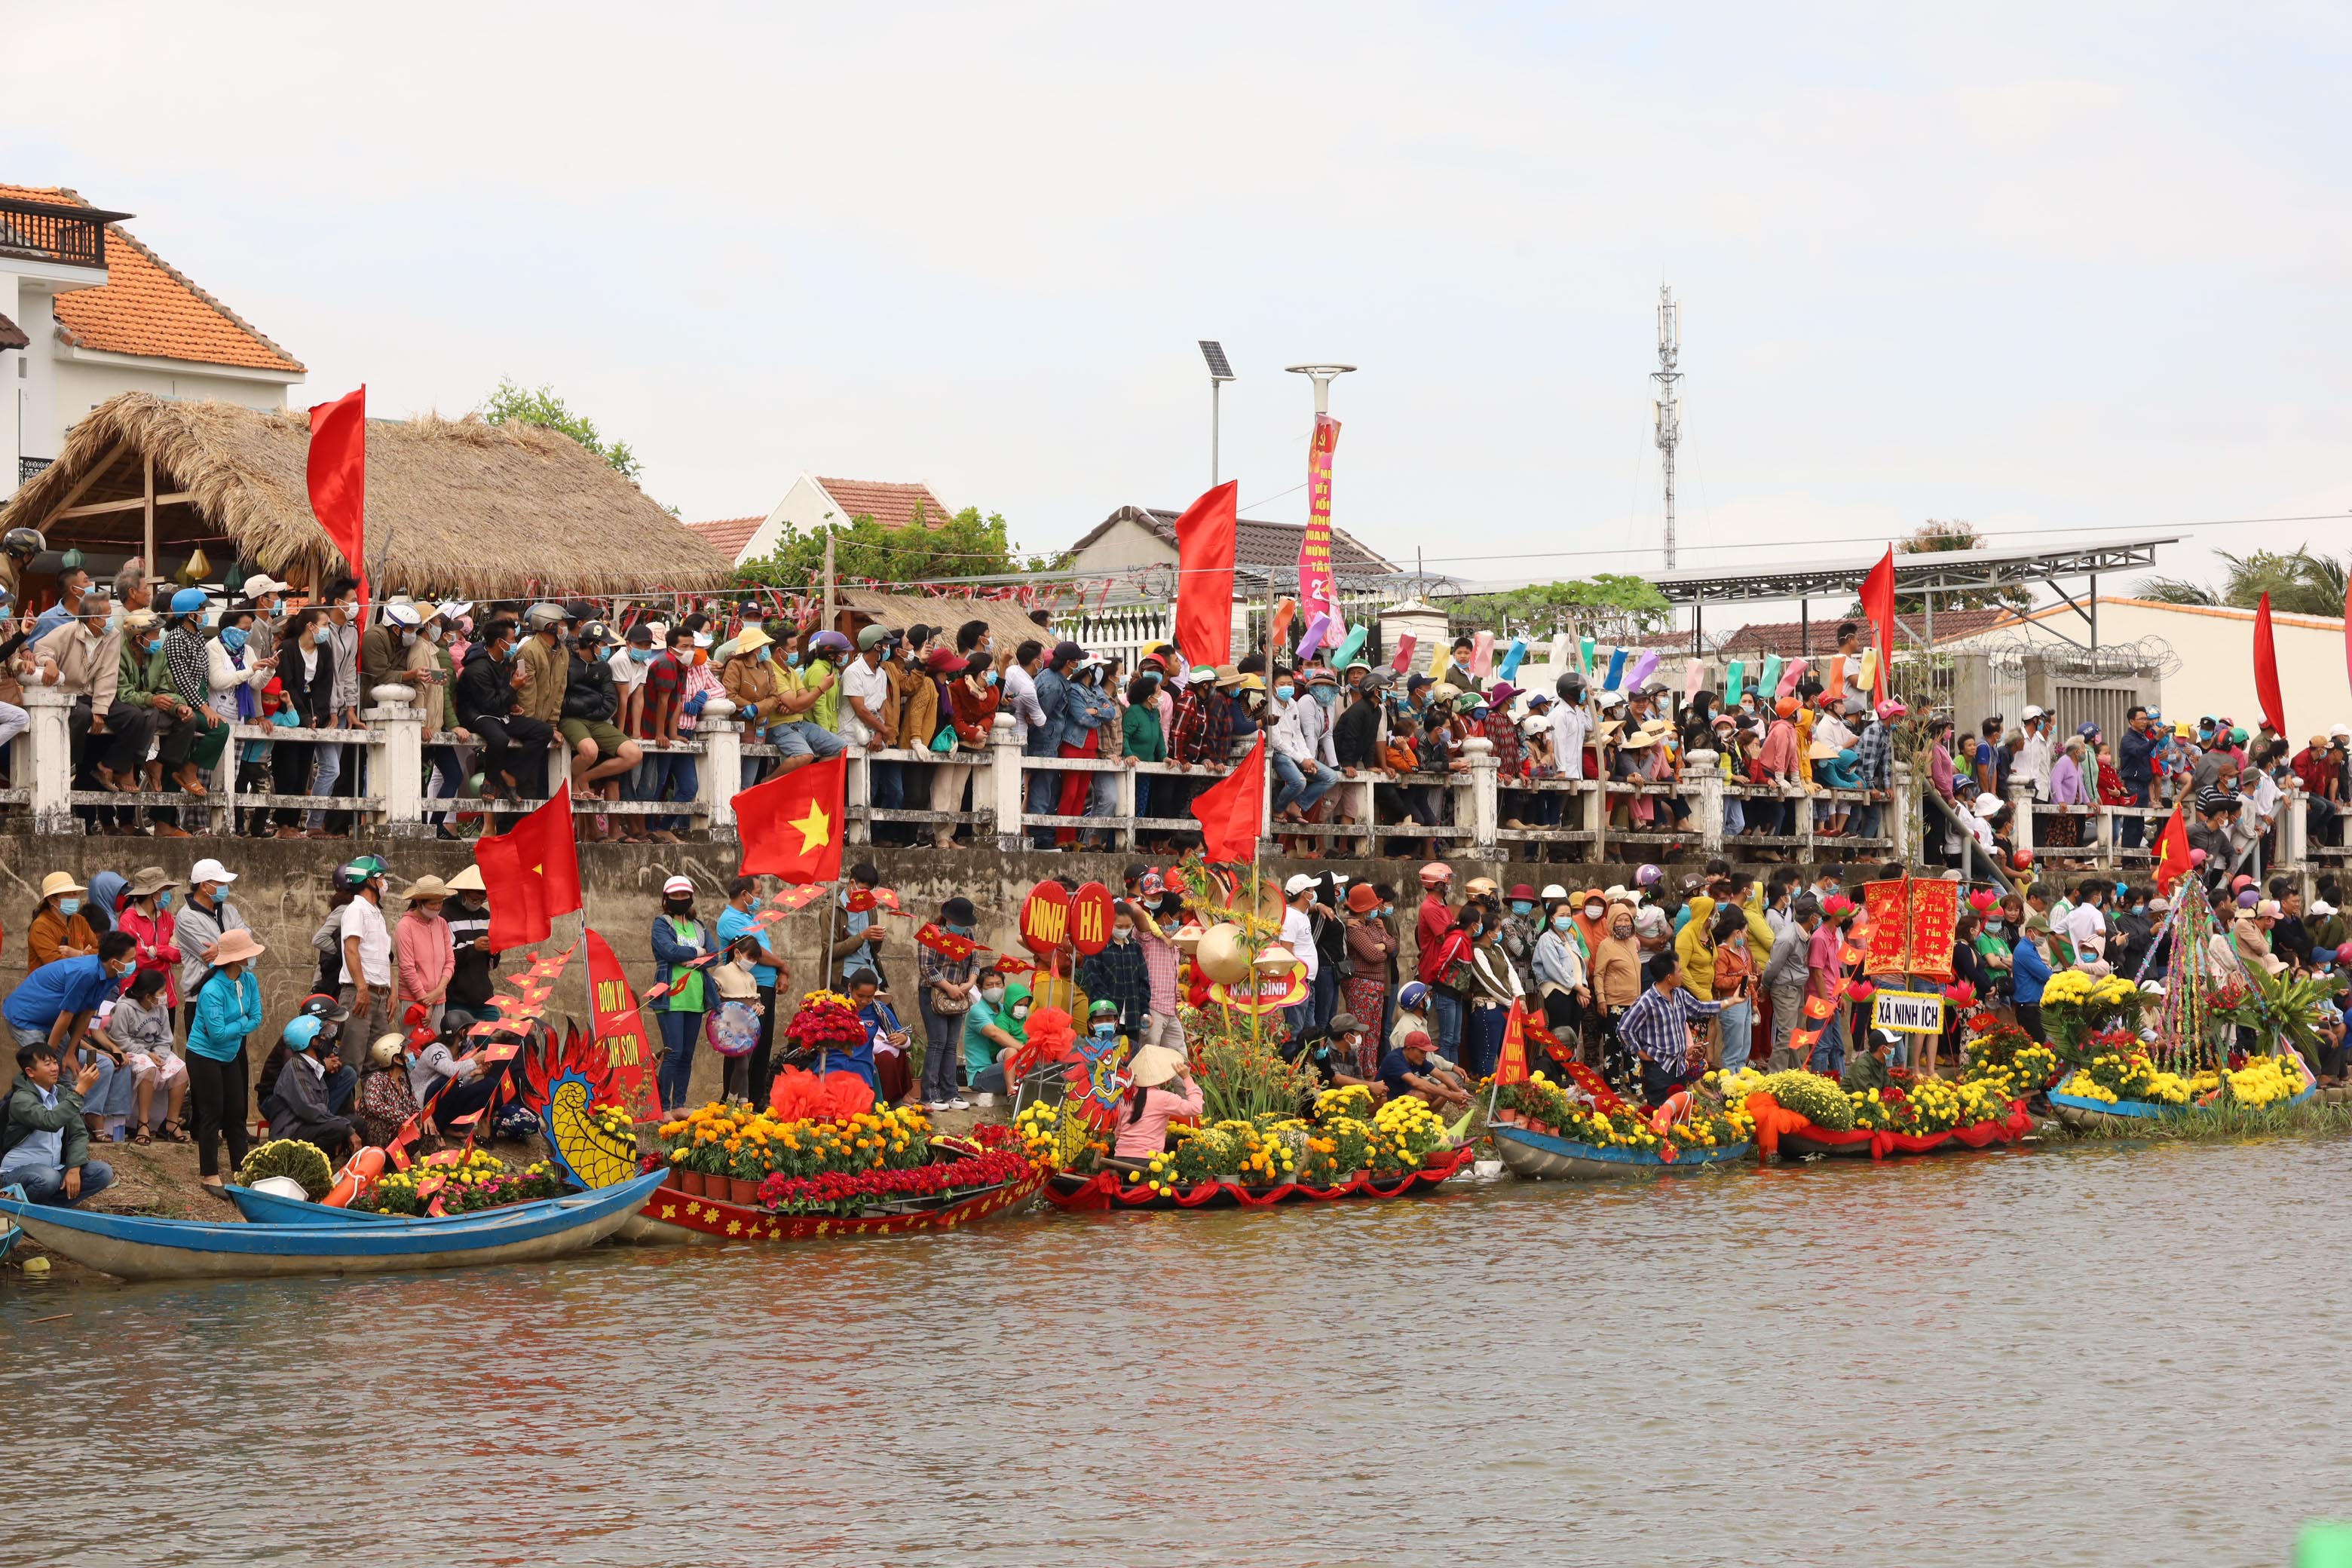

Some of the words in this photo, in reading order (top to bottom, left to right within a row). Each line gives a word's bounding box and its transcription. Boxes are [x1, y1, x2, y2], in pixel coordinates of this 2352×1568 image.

[1306, 529, 1330, 541] QUAN
[1026, 896, 1067, 944] NINH
[1080, 895, 1103, 942] HÀ
[1925, 940, 1940, 951] Lộc
[1878, 997, 1891, 1024] XÃ
[1894, 1003, 1918, 1025] NINH
[1922, 1000, 1938, 1027] ÍCH
[620, 1031, 639, 1067] SƠN
[1505, 1043, 1523, 1062] NINH
[1505, 1064, 1521, 1083] SIM
